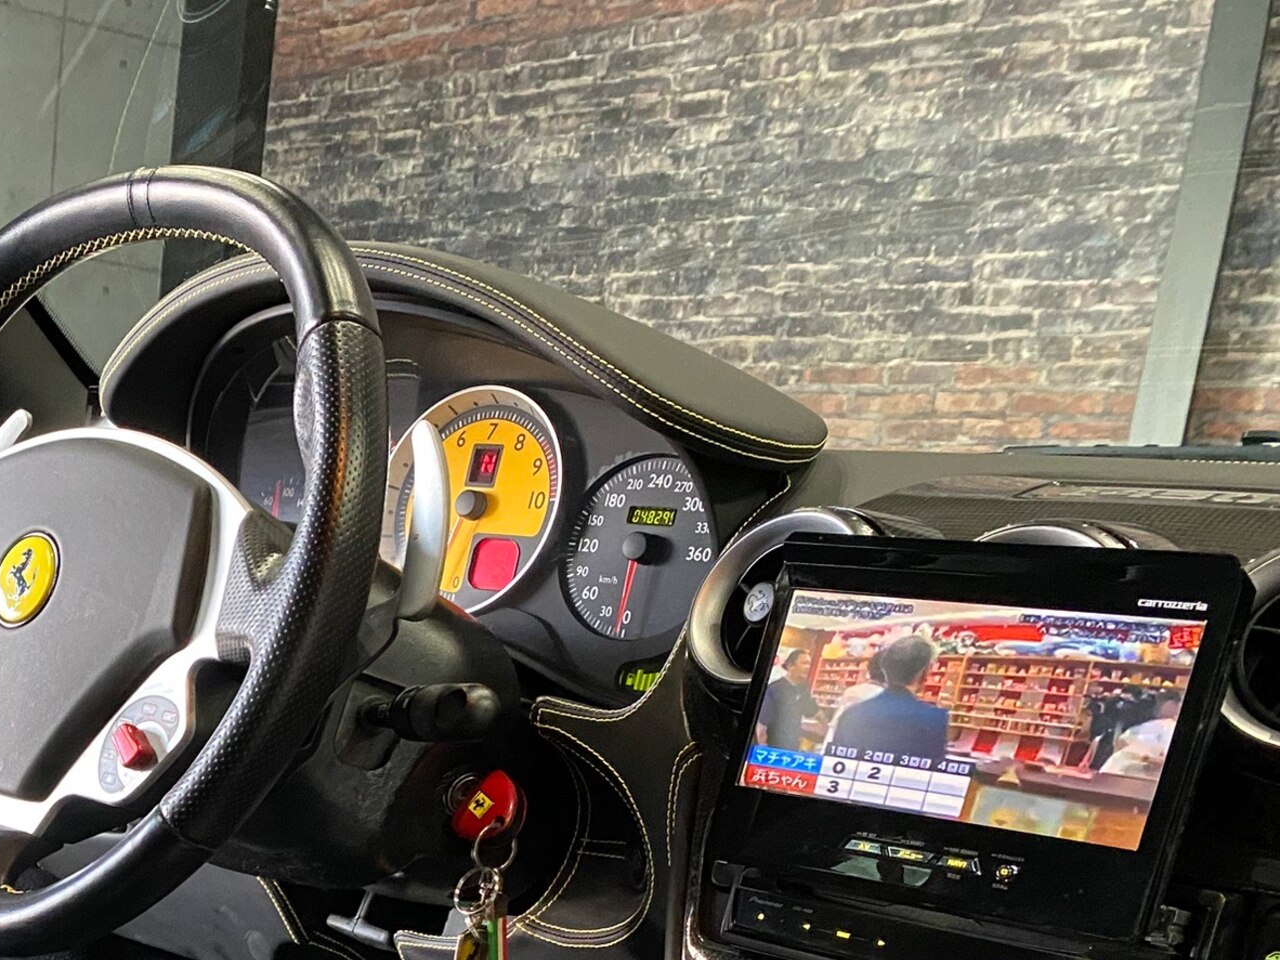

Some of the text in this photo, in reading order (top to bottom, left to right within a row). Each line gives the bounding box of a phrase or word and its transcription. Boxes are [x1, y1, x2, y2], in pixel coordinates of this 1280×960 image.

[487, 423, 499, 440] 7
[457, 431, 467, 447] 6
[514, 433, 526, 451] 8
[532, 458, 543, 476] 9
[627, 479, 644, 490] 210
[647, 474, 673, 488] 240
[674, 481, 693, 493] 270
[528, 491, 546, 509] 10
[604, 493, 626, 508] 180
[588, 515, 604, 526] 150
[695, 522, 710, 534] 33
[578, 538, 599, 553] 120
[685, 546, 712, 562] 360
[576, 565, 589, 577] 90
[453, 576, 460, 588] 0
[599, 575, 618, 585] km/h
[581, 586, 599, 600] 60
[599, 605, 612, 617] 30
[1137, 598, 1209, 611] carrozzeria
[622, 610, 631, 624] 0
[754, 749, 818, 770] マチャアキ
[832, 761, 882, 780] 0 2
[751, 767, 809, 789] 浜ちゃん
[826, 780, 840, 794] 3
